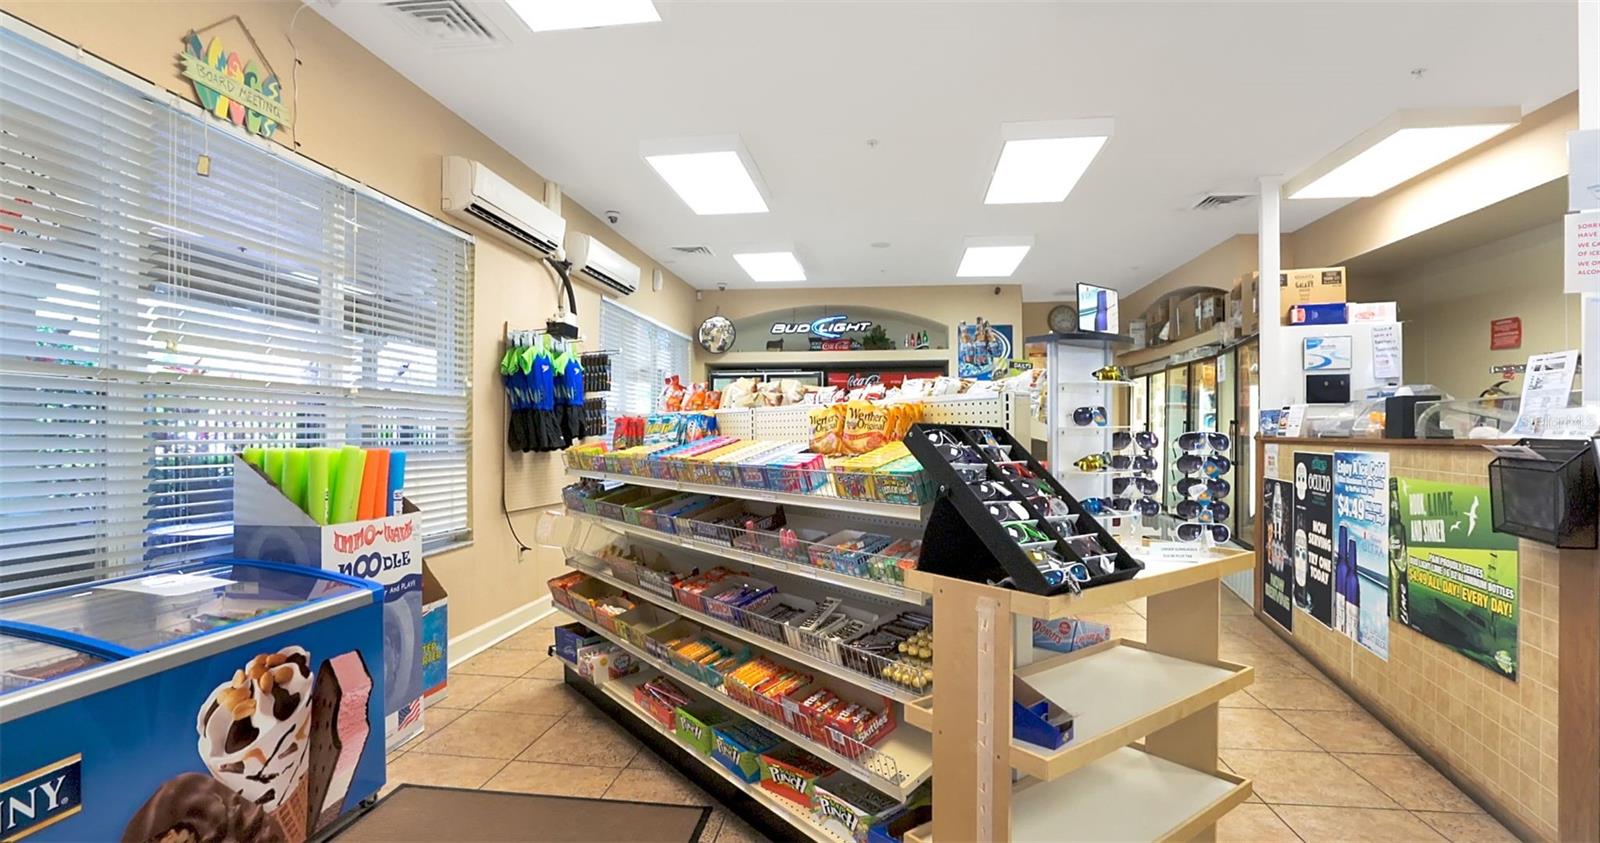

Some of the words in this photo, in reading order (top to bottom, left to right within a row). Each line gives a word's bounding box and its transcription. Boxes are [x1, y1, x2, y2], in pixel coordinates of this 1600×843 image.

[196, 63, 236, 93] BOARD
[239, 88, 281, 118] MEETING
[771, 323, 811, 334] BUD
[820, 322, 873, 333] LIGHT
[1337, 493, 1365, 521] $4.49
[1308, 532, 1332, 552] SERVING
[1441, 579, 1460, 599] DAY!
[1461, 586, 1489, 609] EVERY
[1489, 595, 1513, 618] DAY!
[1487, 580, 1515, 600] BOTTLES
[858, 713, 889, 743] Skittles
[820, 798, 859, 831] PUNCH
